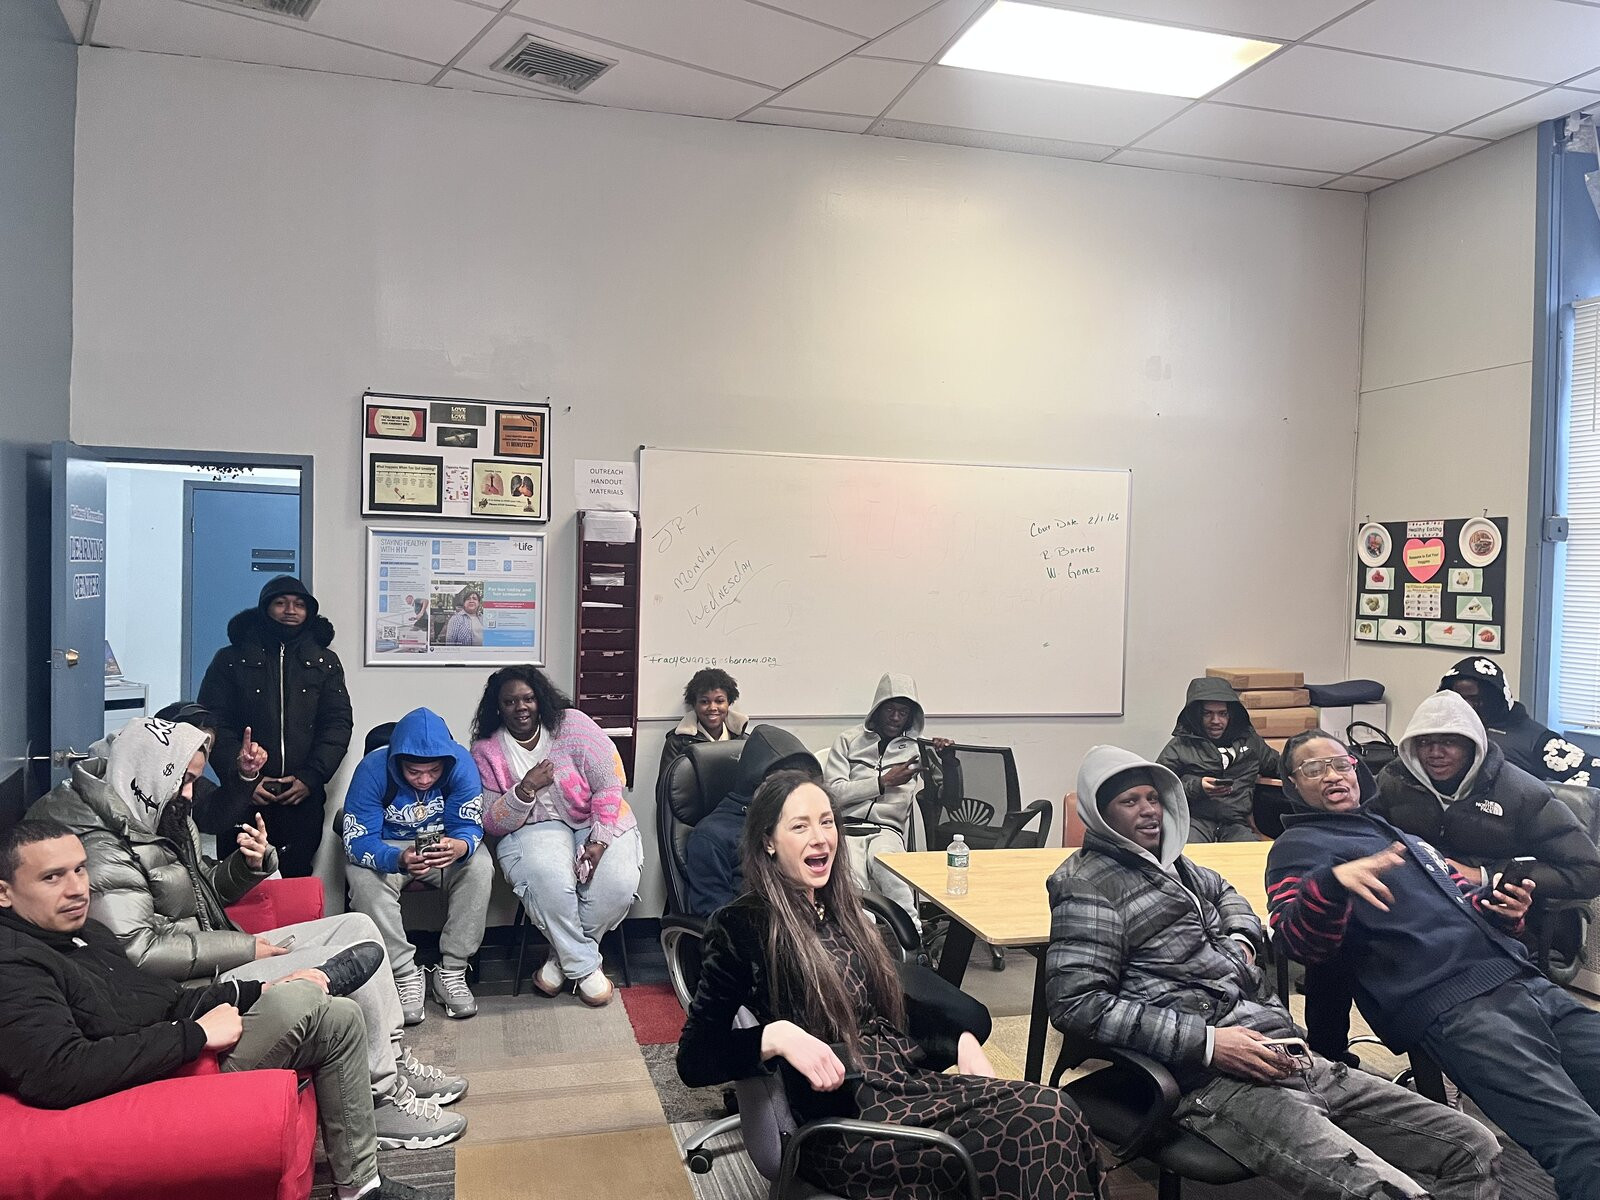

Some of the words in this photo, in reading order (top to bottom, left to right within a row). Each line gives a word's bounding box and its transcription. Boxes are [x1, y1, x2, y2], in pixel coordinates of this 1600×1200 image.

[589, 488, 624, 496] MATERIALS
[70, 536, 103, 562] LEARNING
[404, 539, 427, 547] HEALTHY
[1067, 562, 1101, 579] Gomez
[73, 574, 100, 600] CENTER
